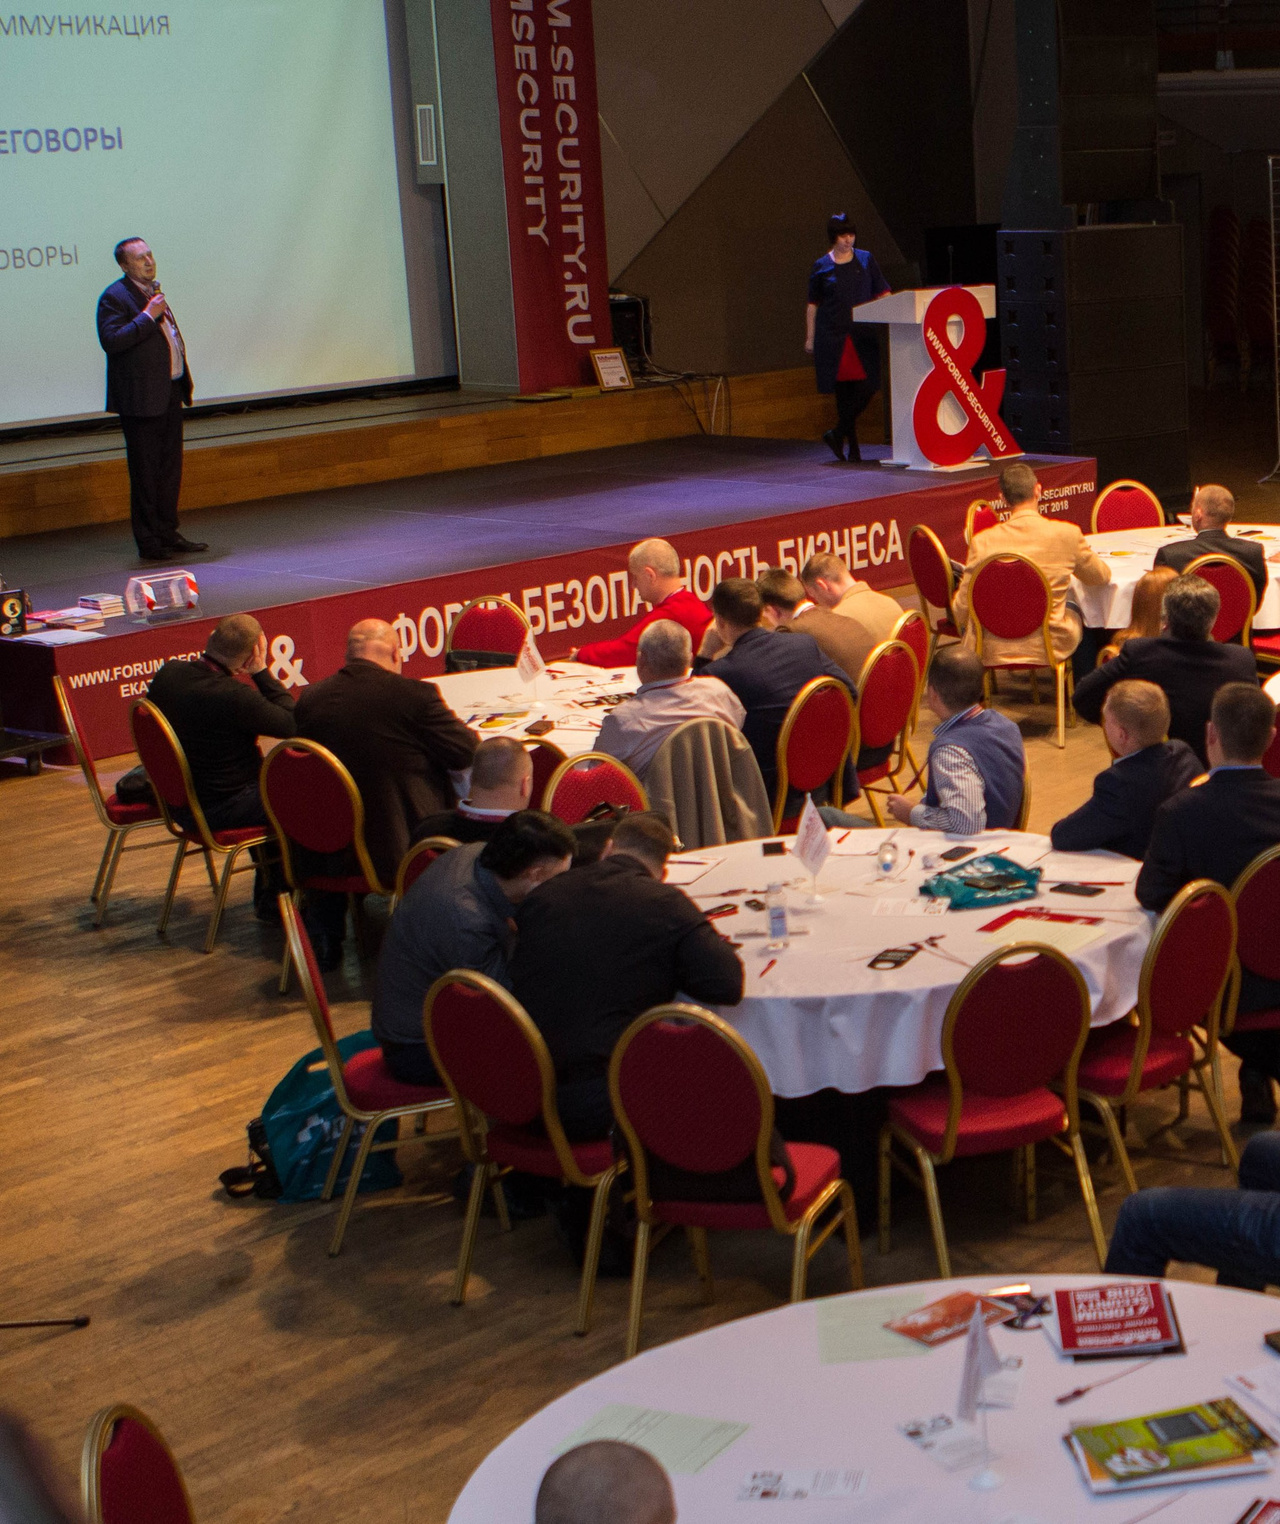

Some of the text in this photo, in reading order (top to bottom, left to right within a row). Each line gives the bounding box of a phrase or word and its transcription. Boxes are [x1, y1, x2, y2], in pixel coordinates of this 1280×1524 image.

[926, 327, 1008, 452] WWW.FORUM-SECURITY.RU
[1051, 500, 1069, 513] 2018
[778, 519, 905, 578] БИЗНЕСА
